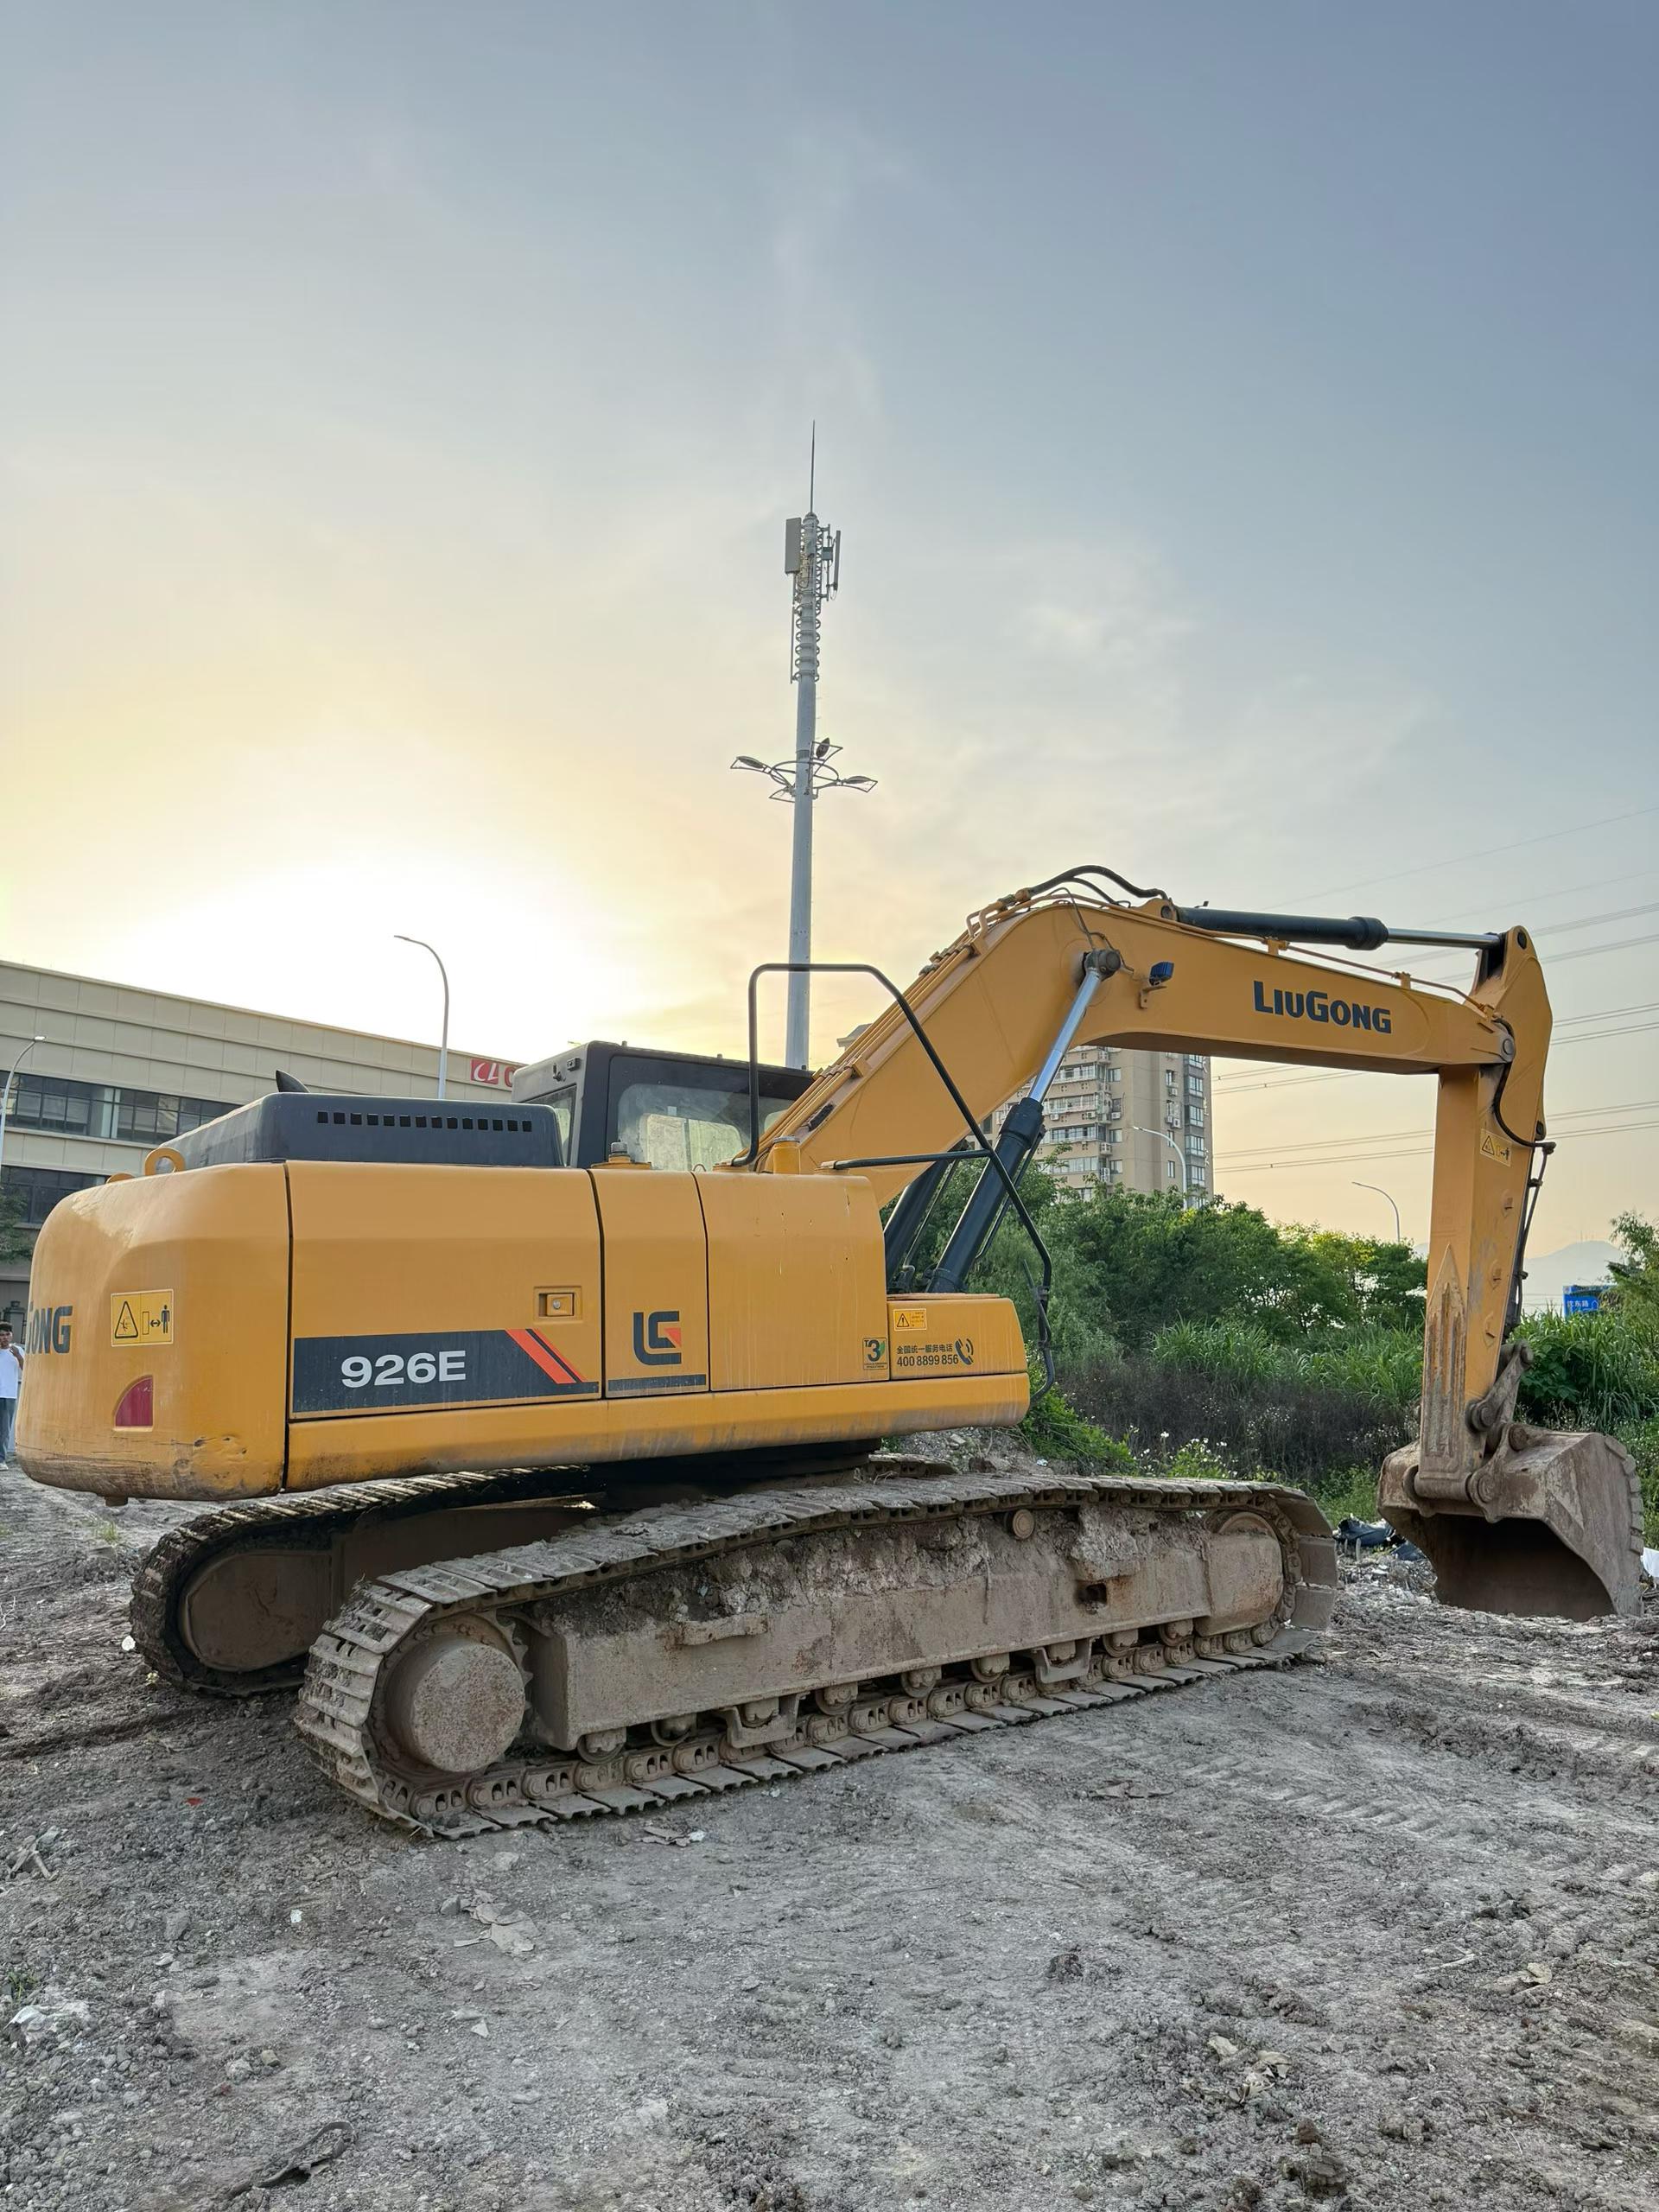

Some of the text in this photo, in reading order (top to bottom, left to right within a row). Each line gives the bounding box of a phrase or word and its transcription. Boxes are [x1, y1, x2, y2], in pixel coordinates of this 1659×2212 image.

[26, 1301, 73, 1354] ONG
[897, 1344, 952, 1354] 全国统一服务电话
[897, 1356, 914, 1366] 400
[917, 1355, 939, 1365] 8899
[942, 1354, 958, 1364] 856
[341, 1351, 466, 1388] 926E
